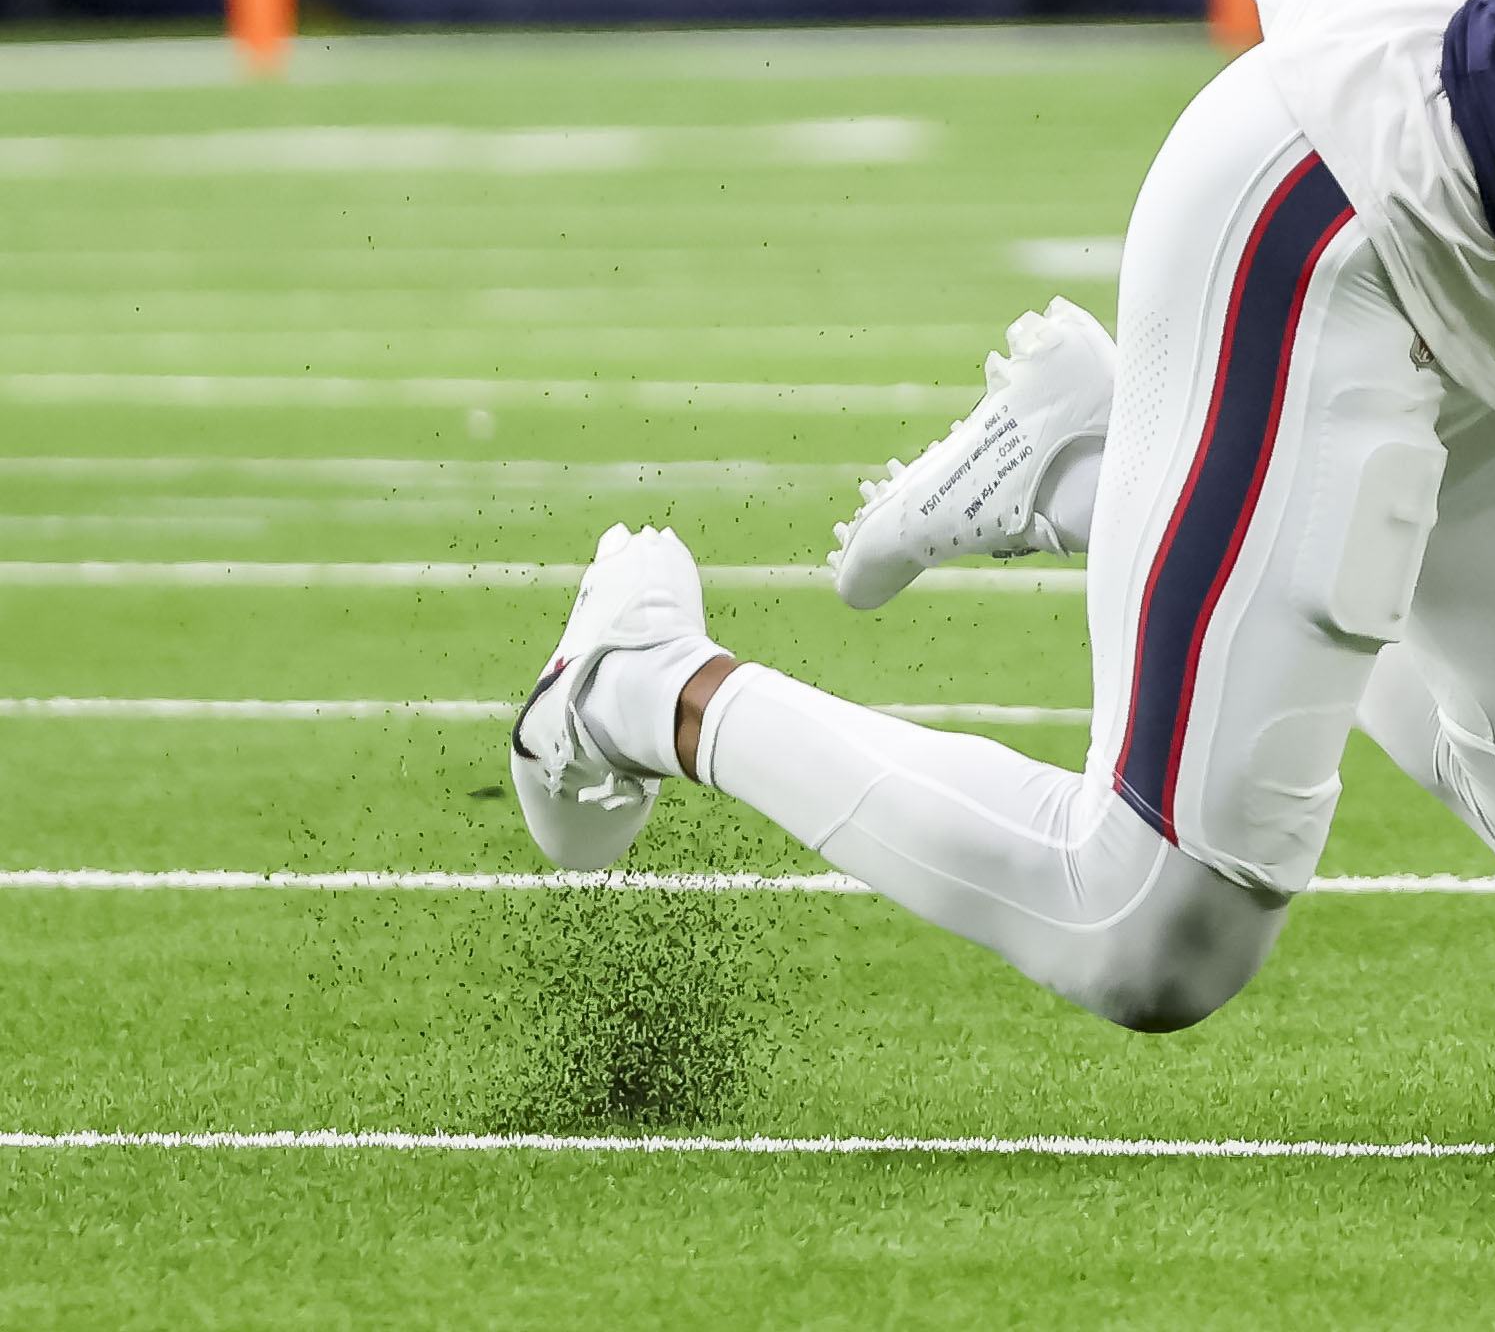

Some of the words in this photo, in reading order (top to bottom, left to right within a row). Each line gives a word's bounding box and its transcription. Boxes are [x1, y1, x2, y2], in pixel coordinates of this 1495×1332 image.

[920, 493, 942, 516] USA
[981, 486, 995, 502] For
[964, 496, 984, 520] NIKE
